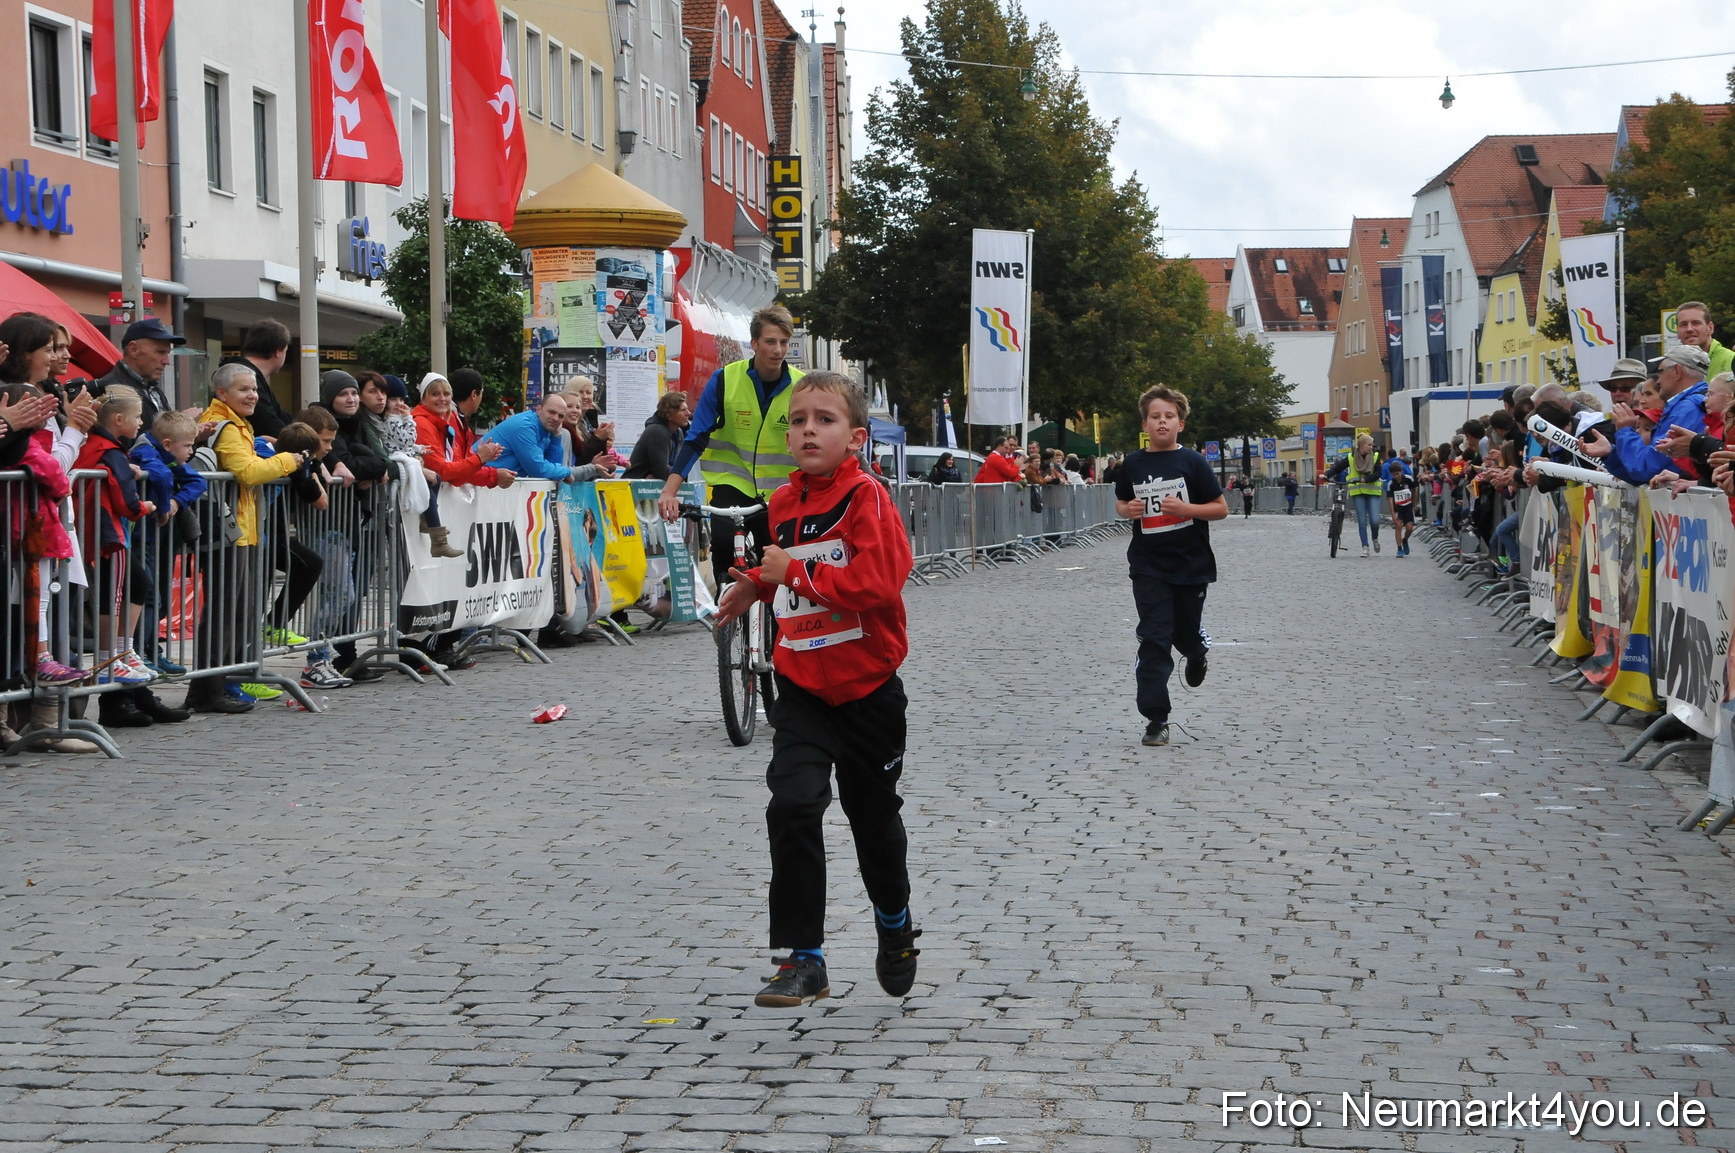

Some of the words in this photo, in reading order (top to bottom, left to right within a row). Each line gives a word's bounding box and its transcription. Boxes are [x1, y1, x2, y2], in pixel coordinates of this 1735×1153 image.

[548, 363, 599, 374] GLENN
[1152, 484, 1177, 493] Neumarkt
[803, 524, 818, 534] L.F.
